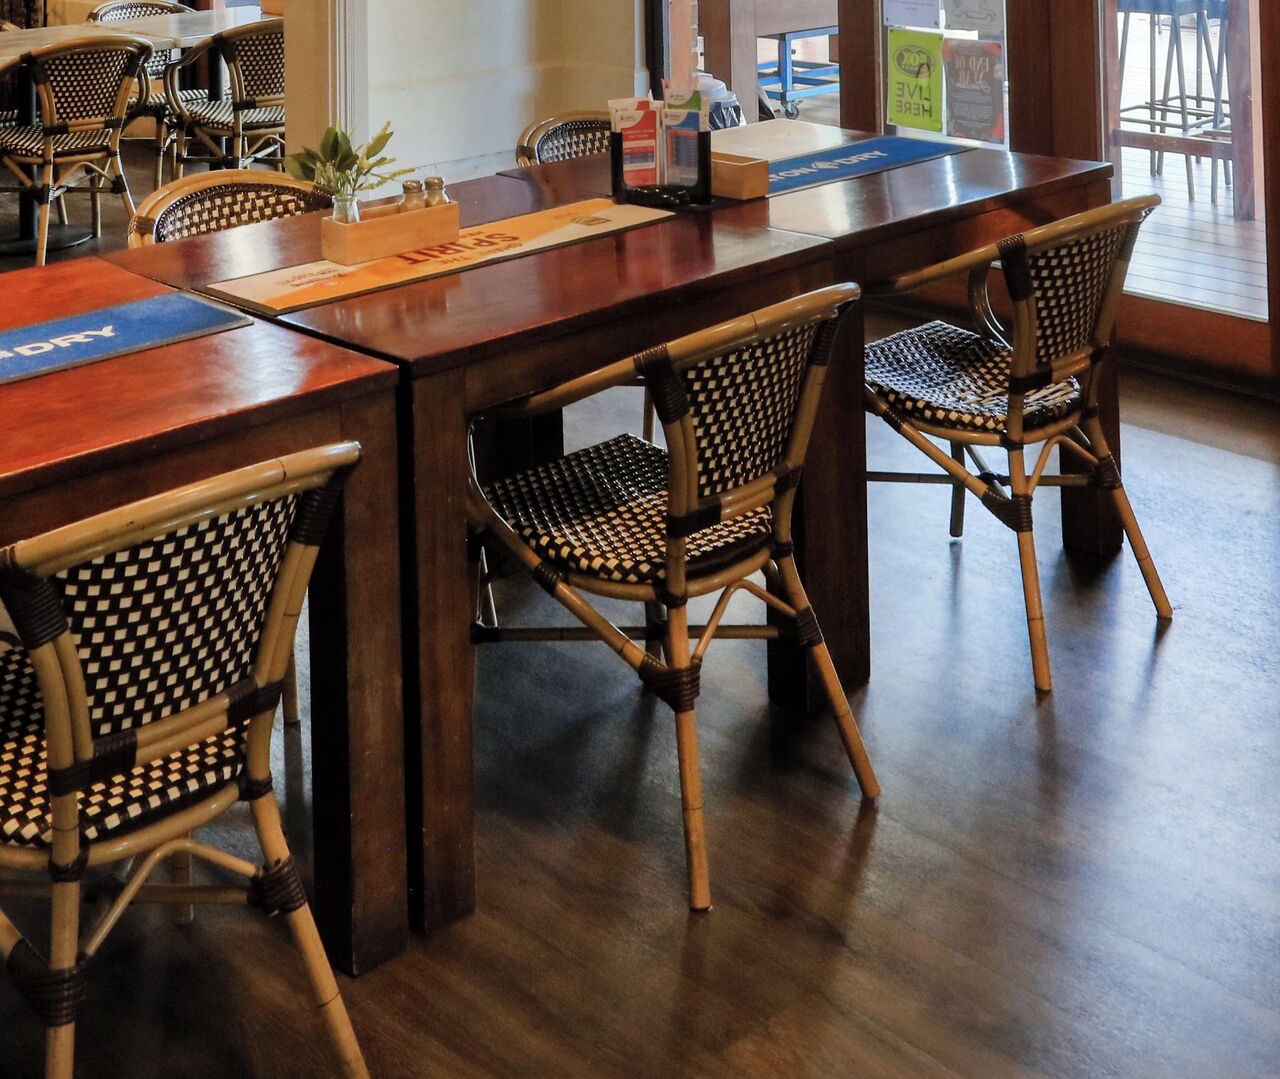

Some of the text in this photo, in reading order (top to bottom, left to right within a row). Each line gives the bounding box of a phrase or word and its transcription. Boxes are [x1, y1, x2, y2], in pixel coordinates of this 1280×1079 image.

[833, 150, 889, 165] DRY
[396, 233, 521, 265] SPIRIT
[13, 324, 119, 357] DRY
